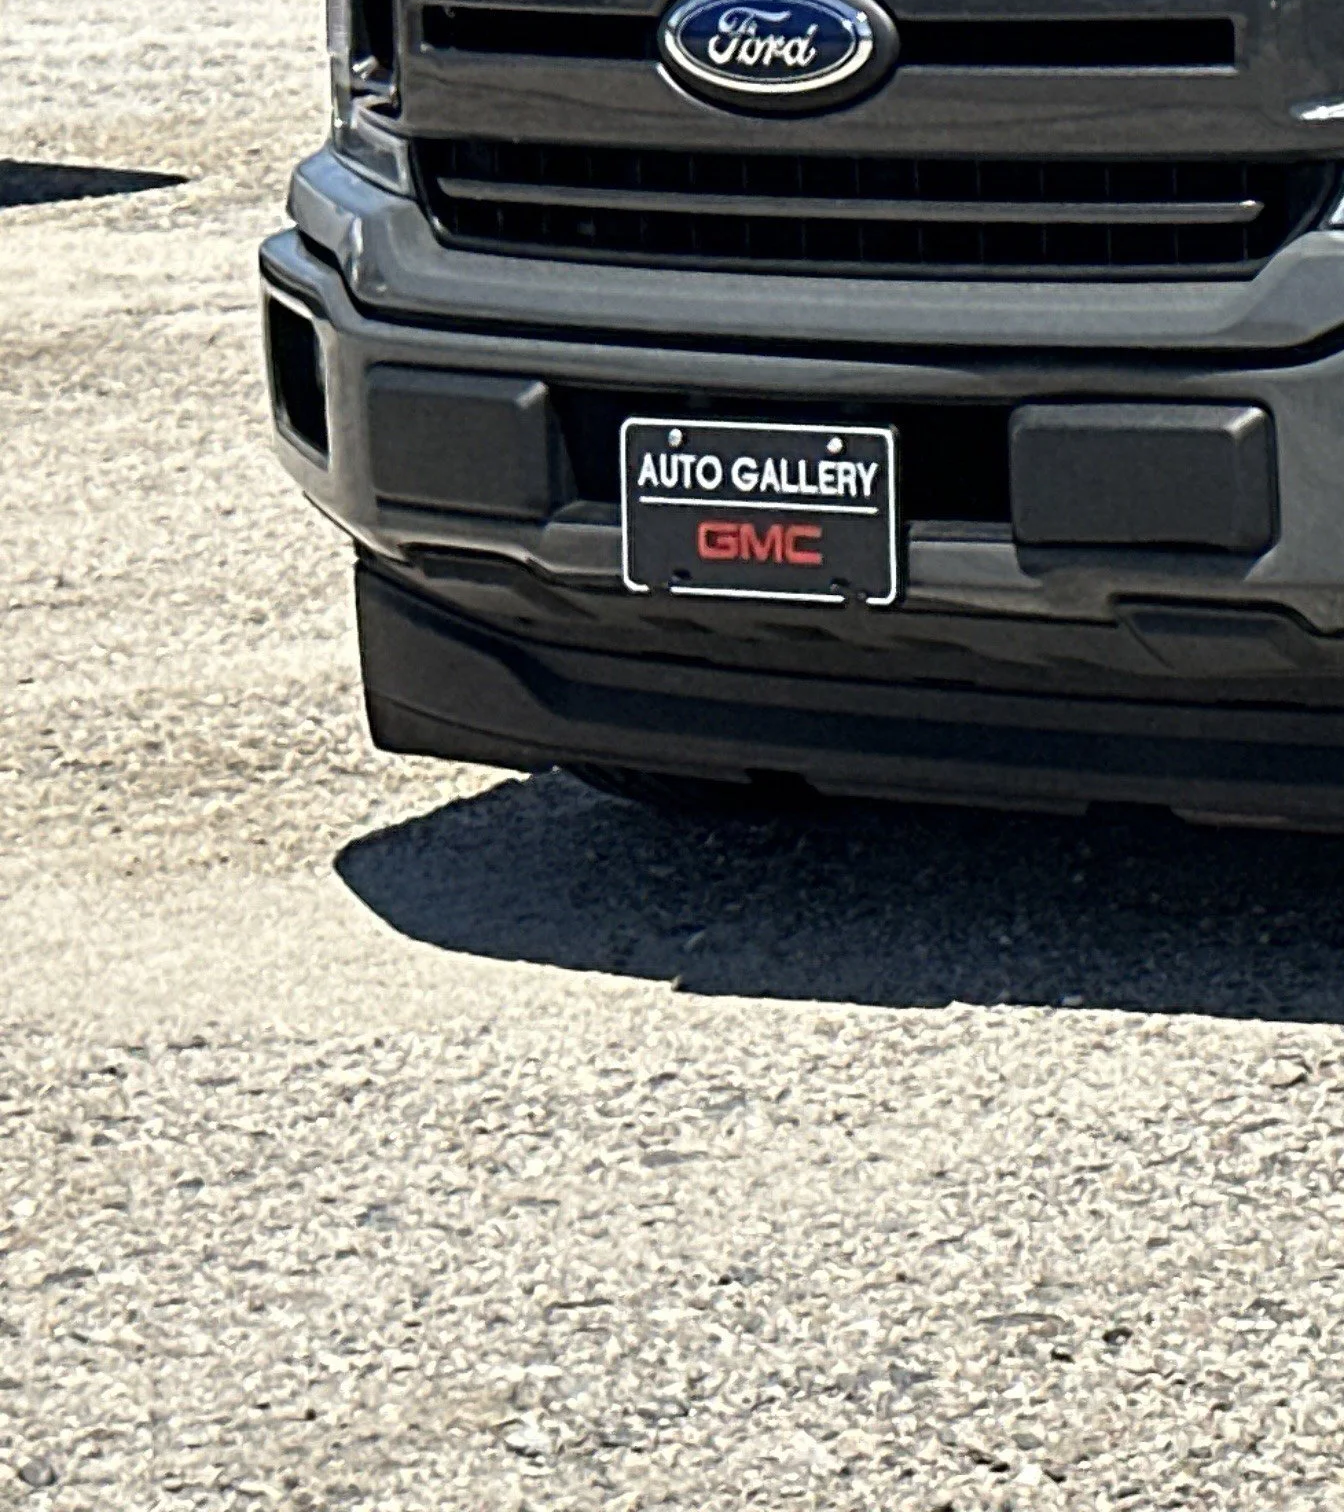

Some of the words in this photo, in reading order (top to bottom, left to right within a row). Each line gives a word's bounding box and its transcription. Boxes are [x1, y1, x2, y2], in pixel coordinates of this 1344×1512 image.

[707, 6, 819, 67] Ford
[637, 452, 723, 491] AUTO
[731, 456, 879, 498] GALLERY
[697, 520, 823, 566] GMC
